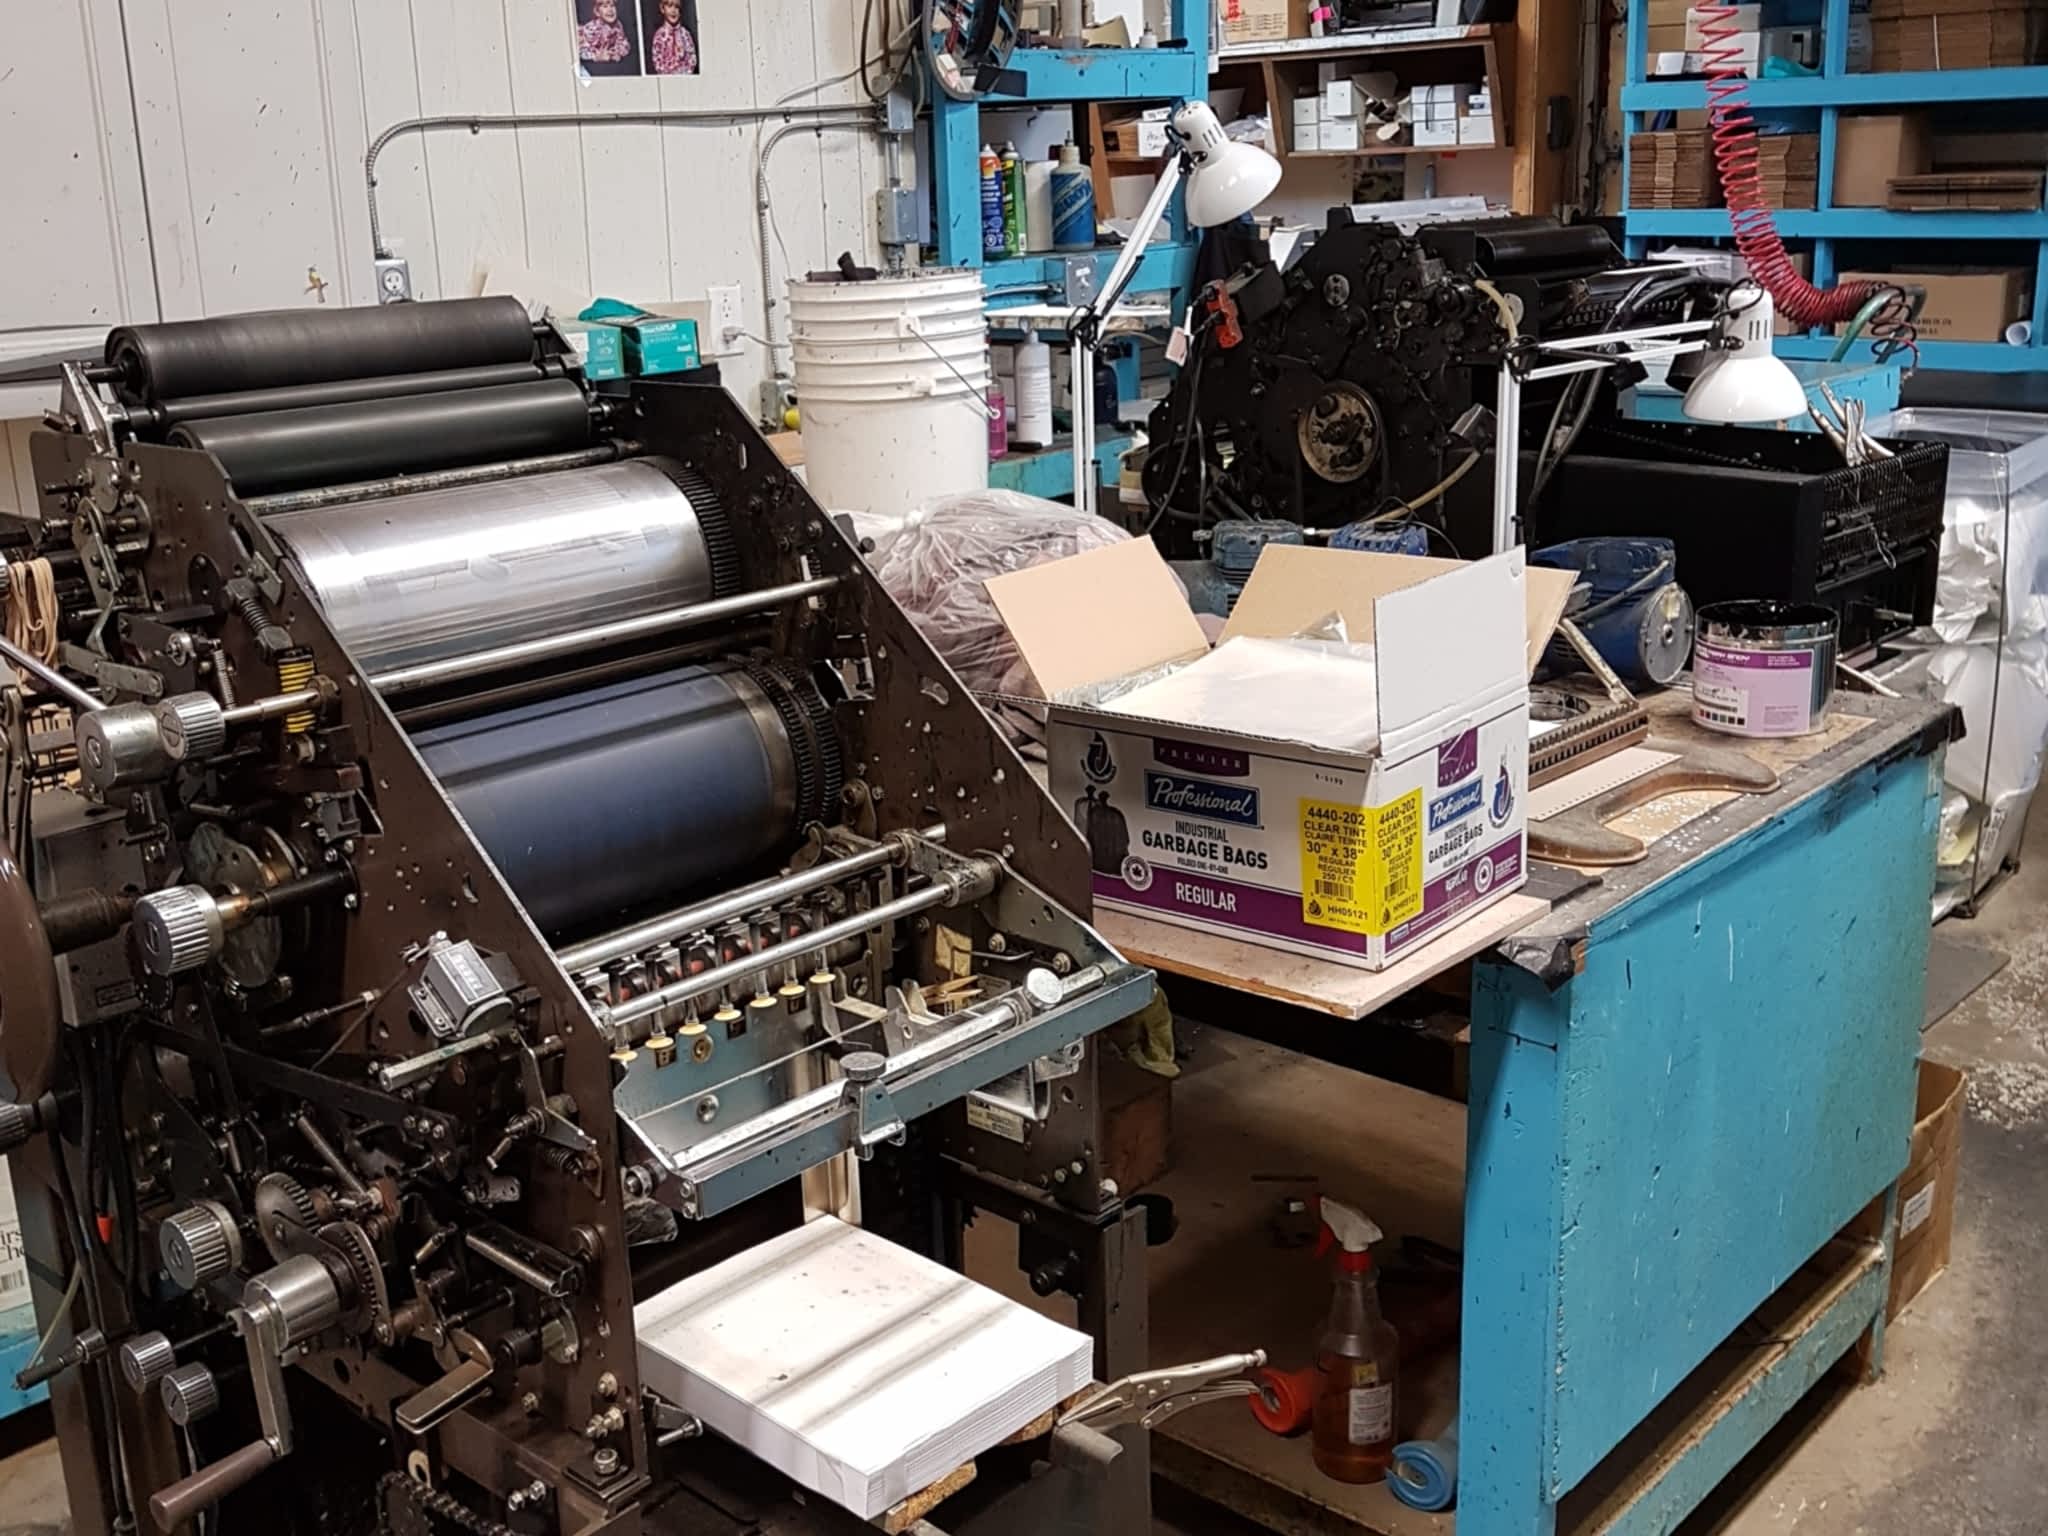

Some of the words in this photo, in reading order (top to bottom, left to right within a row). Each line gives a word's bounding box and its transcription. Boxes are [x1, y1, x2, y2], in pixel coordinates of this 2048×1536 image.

[1159, 748, 1241, 768] PREMIER
[1153, 778, 1253, 816] Professional
[1307, 807, 1366, 826] 4440-202
[1379, 798, 1416, 824] 4440-202
[1176, 820, 1229, 842] INDUSTRIAL
[1304, 820, 1341, 834] CLEAR
[1344, 826, 1366, 838] TINT
[1378, 819, 1402, 838] CLEAR
[1403, 811, 1417, 825] TINT
[1142, 830, 1219, 860] GARBAGE
[1224, 846, 1268, 870] BAGS
[1304, 832, 1336, 844] CLAIRE
[1338, 837, 1367, 848] TEINTE
[1306, 841, 1328, 854] 30"
[1332, 848, 1338, 858] x
[1343, 848, 1364, 860] 38"
[1428, 834, 1462, 863] GARBAGE
[1464, 824, 1484, 844] BAGS
[1318, 855, 1356, 868] REGULAR
[1176, 882, 1237, 913] REGULAR
